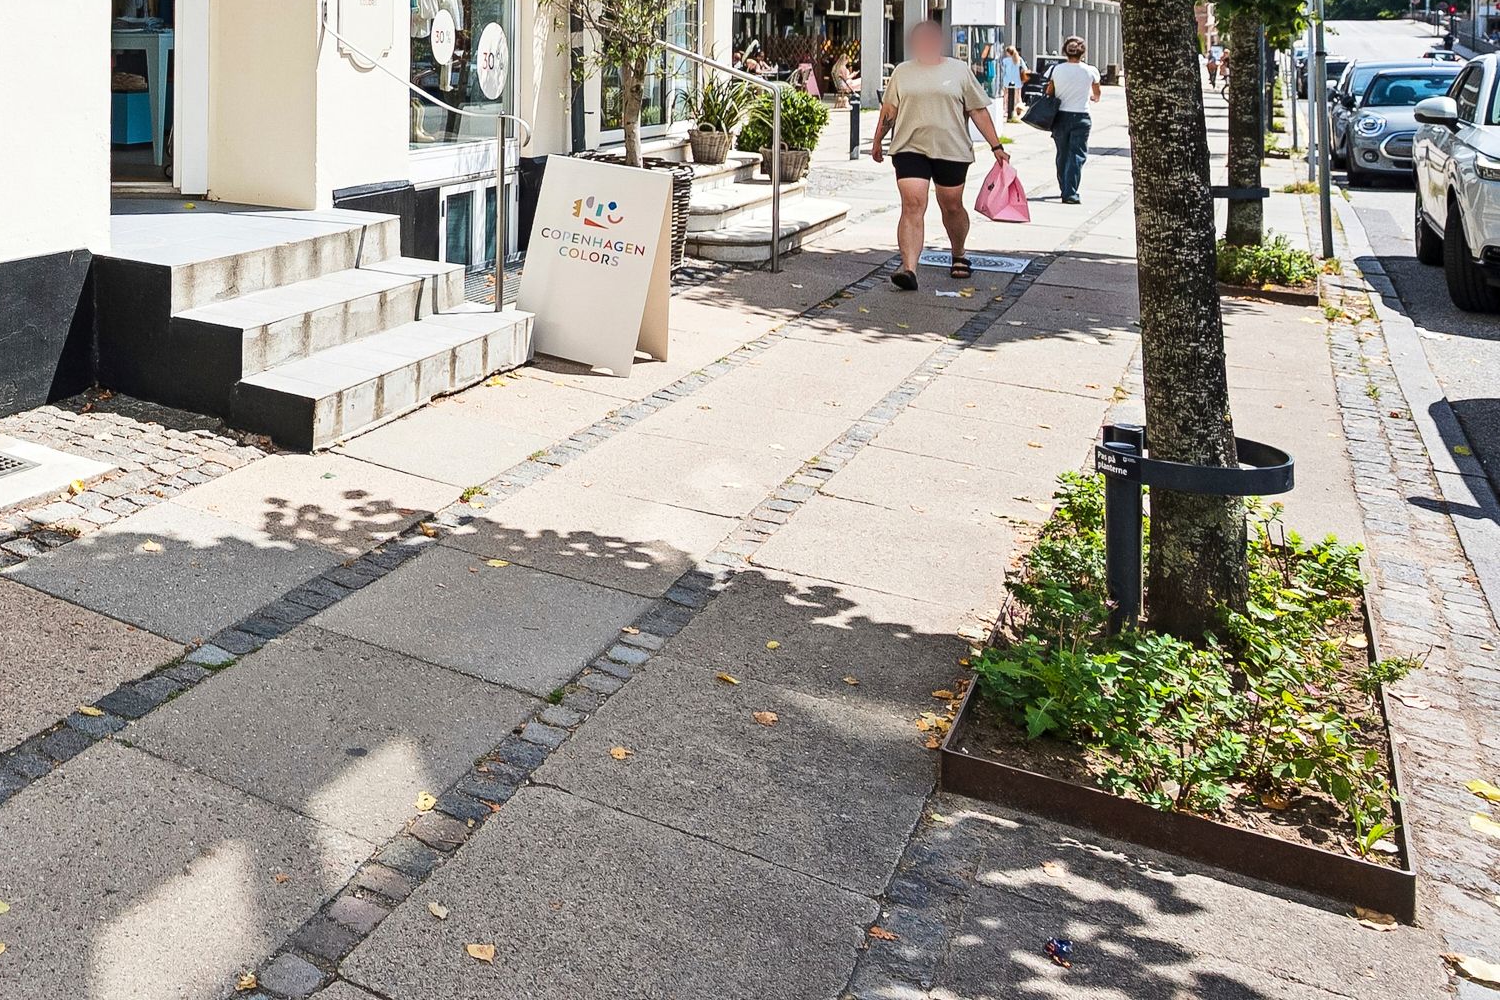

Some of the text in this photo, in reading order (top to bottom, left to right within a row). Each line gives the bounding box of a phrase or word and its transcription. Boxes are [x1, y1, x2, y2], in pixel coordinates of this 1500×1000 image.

[482, 52, 495, 70] 30
[541, 227, 645, 256] COPENHAGEN
[559, 246, 620, 267] COLORS
[1097, 450, 1107, 461] Pas
[1107, 455, 1116, 463] på
[1097, 461, 1128, 476] planterne
